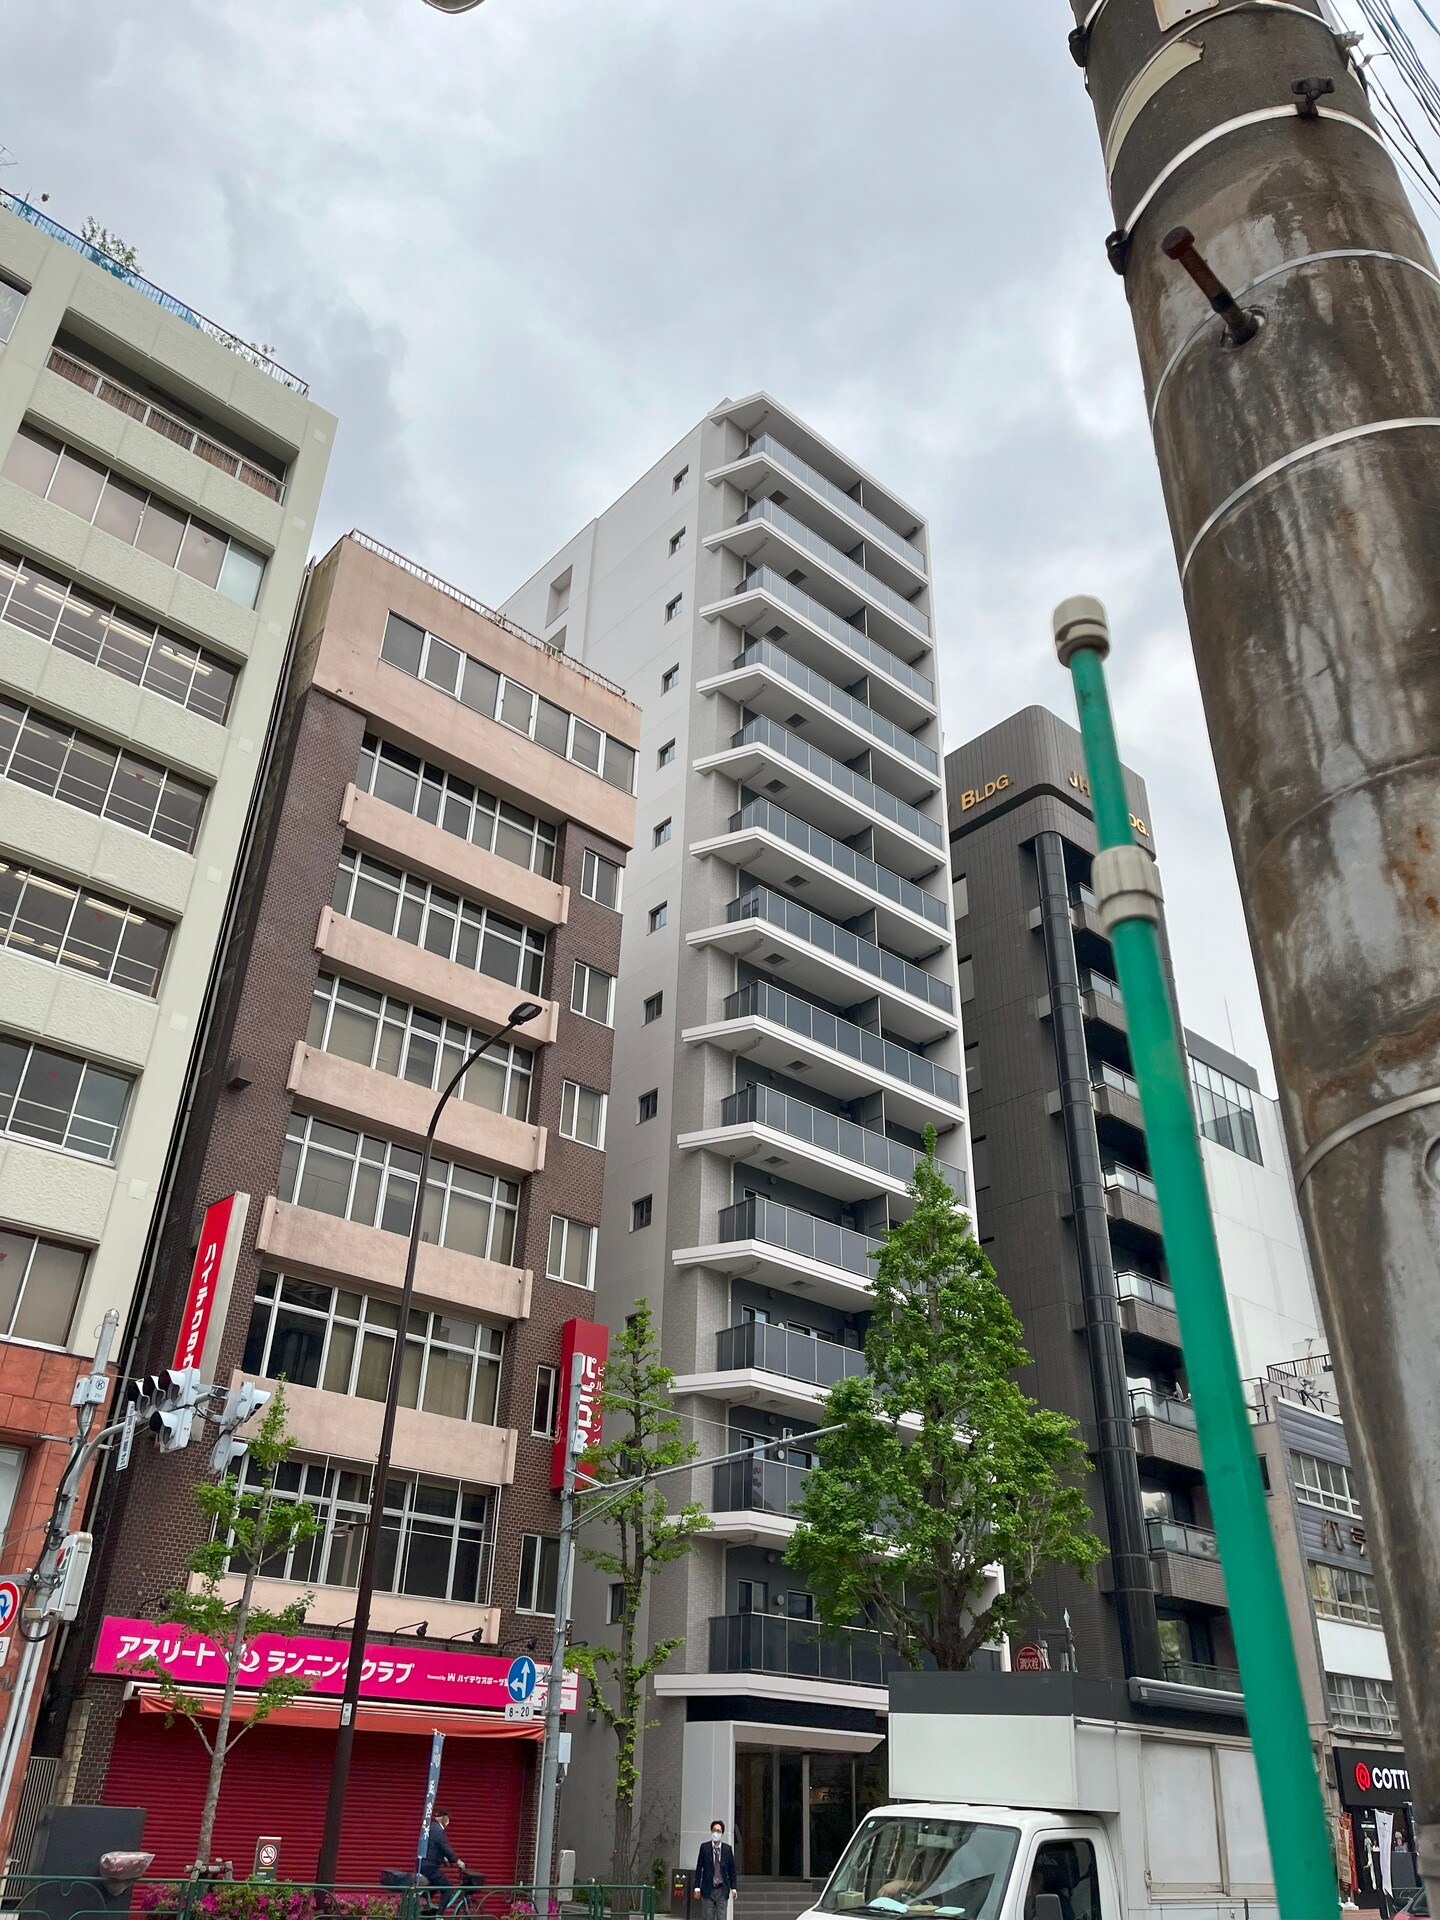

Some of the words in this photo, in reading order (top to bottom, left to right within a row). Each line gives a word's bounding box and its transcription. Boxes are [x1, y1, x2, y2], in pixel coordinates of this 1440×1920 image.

[961, 774, 1014, 812] BLDG.
[577, 1354, 598, 1450] パピロ
[592, 1366, 606, 1450] ビルング
[116, 1635, 216, 1667] アスリート
[1020, 1657, 1040, 1670] 消火栓
[457, 1674, 509, 1687] ハイテクスポーツ
[508, 1706, 530, 1718] 8-20
[1372, 1767, 1411, 1790] COTTI
